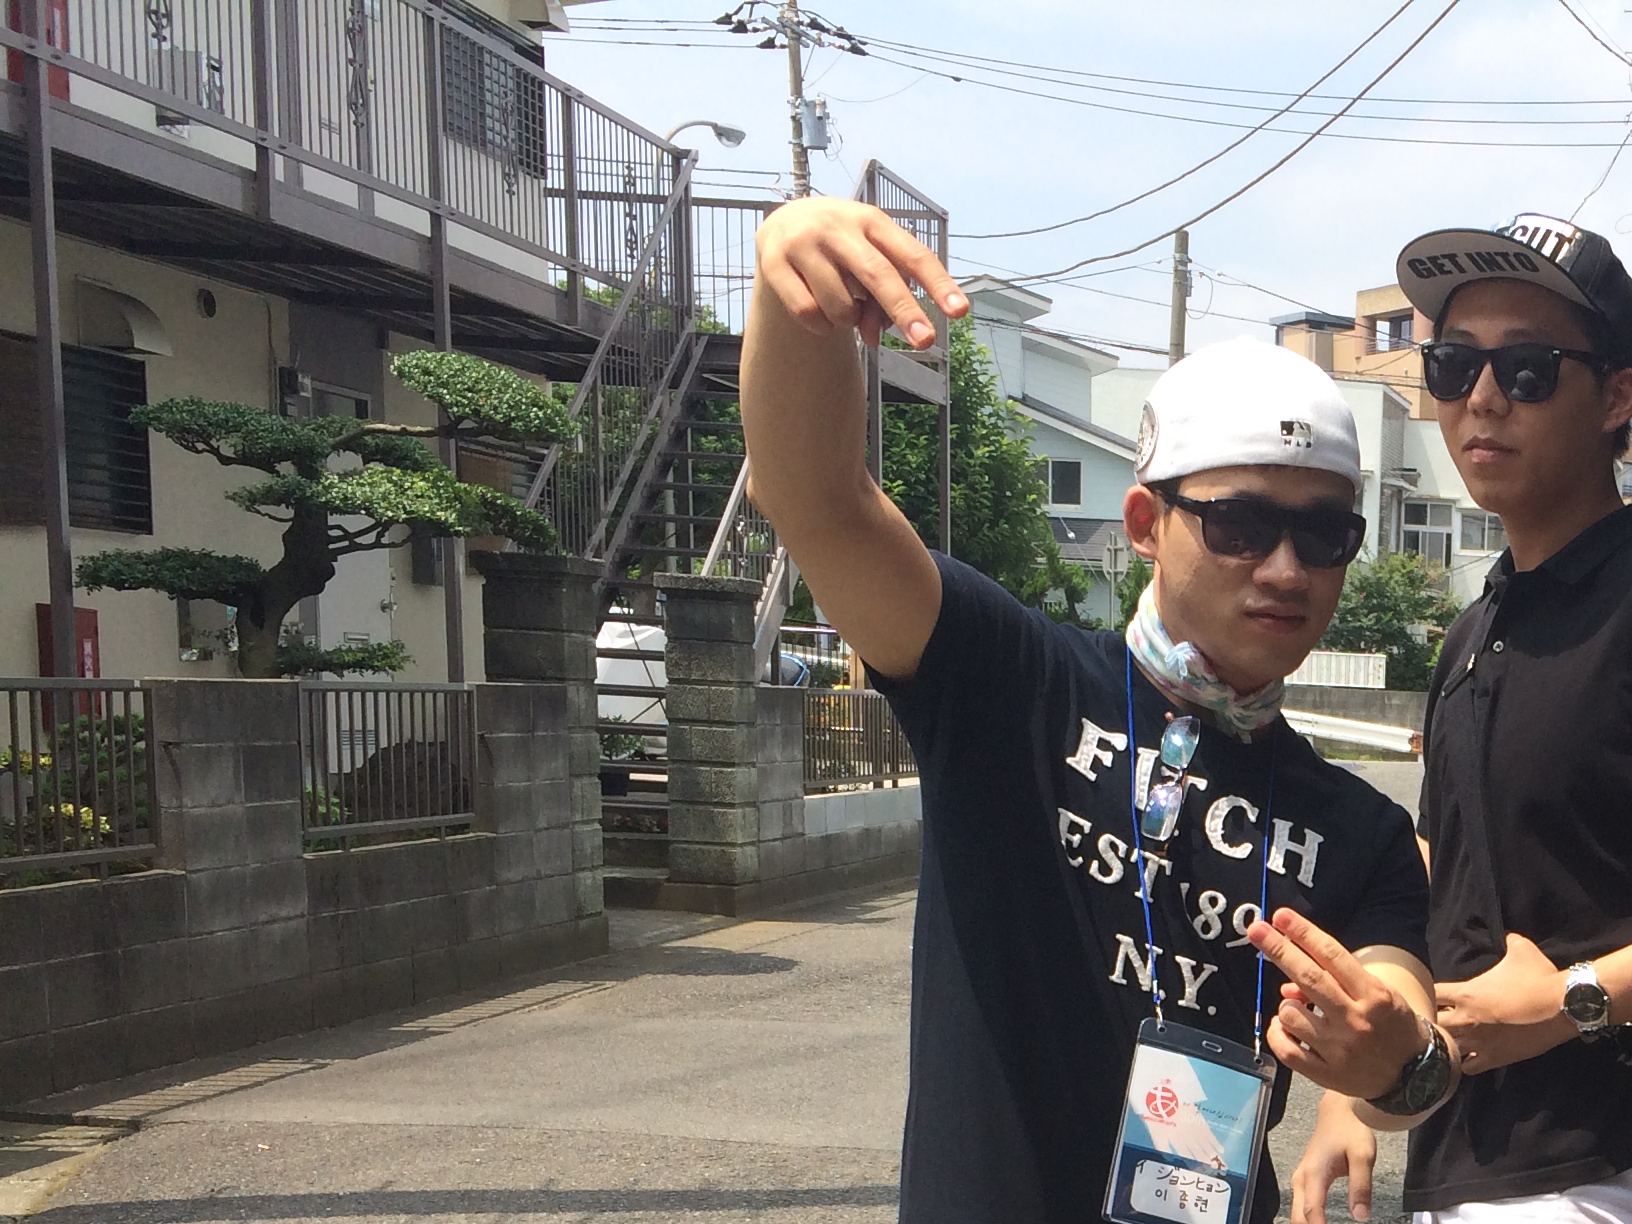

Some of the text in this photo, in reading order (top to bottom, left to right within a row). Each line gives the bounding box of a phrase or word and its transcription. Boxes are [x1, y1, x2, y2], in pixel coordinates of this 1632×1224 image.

[1407, 251, 1540, 280] GET INTO
[1284, 439, 1312, 448] MLB
[1058, 808, 1172, 902] EST
[1109, 933, 1219, 1016] N.Y.
